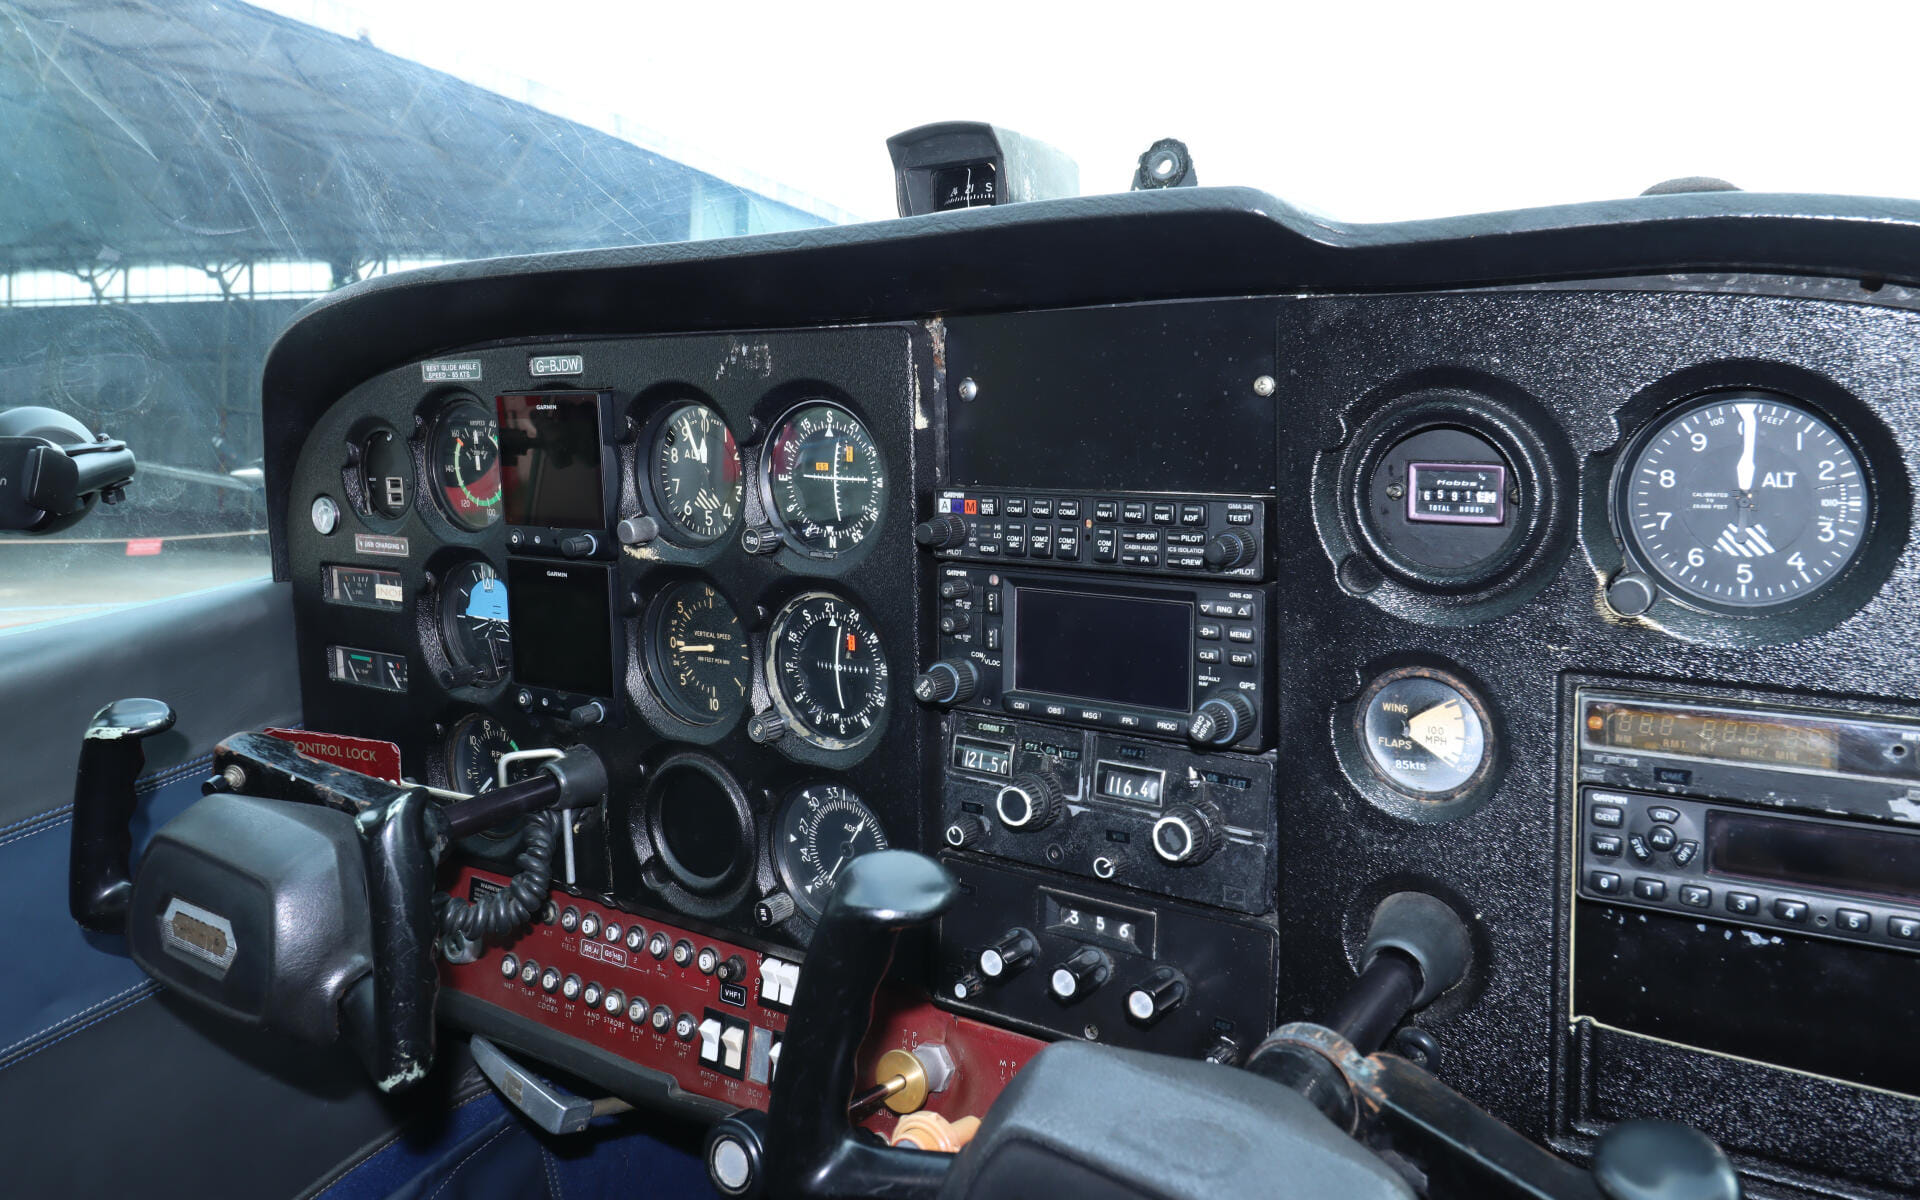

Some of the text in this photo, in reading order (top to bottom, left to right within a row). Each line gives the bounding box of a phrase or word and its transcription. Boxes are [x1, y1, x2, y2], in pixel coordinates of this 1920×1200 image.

[985, 182, 993, 192] S
[536, 358, 579, 373] G-BJDW
[428, 371, 446, 379] SPEED
[826, 410, 833, 423] S
[1709, 417, 1725, 427] 100
[1761, 415, 1786, 427] FEET
[800, 417, 811, 431] 15
[849, 419, 860, 433] 21
[783, 440, 795, 453] 12
[1690, 432, 1708, 452] 9
[1797, 431, 1803, 451] 1
[671, 447, 679, 463] 8
[445, 465, 455, 473] 140
[1817, 460, 1836, 481] 2
[778, 473, 789, 482] E
[1436, 479, 1478, 487] Hobbs
[1659, 468, 1676, 488] 8
[1761, 471, 1797, 488] ALT
[671, 478, 681, 494] 7
[943, 491, 965, 499] GARMIN
[461, 500, 471, 508] 120
[684, 500, 692, 516] 6
[966, 501, 975, 512] M
[1428, 504, 1485, 514] TOTAL HOURS
[486, 508, 496, 517] 100
[722, 503, 733, 519] 4
[1006, 506, 1023, 514] COM1
[1032, 507, 1049, 515] COM2
[1058, 508, 1076, 516] COM3
[1124, 511, 1142, 519] NAV2
[705, 510, 713, 526] 5
[1154, 513, 1170, 521] DME
[1183, 514, 1199, 522] ADF
[1228, 514, 1248, 522] TEST
[1656, 512, 1673, 531] 7
[851, 529, 864, 543] 33
[1817, 521, 1836, 542] 3
[829, 535, 837, 549] N
[1031, 535, 1049, 543] COM2
[1058, 537, 1075, 545] COM3
[1097, 539, 1112, 547] COM
[1180, 534, 1201, 542] PILOT
[375, 542, 400, 550] CHARGING
[1167, 545, 1177, 553] ICS
[1180, 558, 1202, 566] CREW
[1688, 547, 1705, 567] 6
[1786, 551, 1806, 571] 4
[546, 570, 568, 578] GARMIN
[946, 569, 967, 577] GARMIN
[1736, 563, 1753, 584] 5
[1229, 591, 1242, 599] GNS
[677, 601, 684, 614] 5
[824, 602, 834, 613] 21
[1216, 605, 1233, 614] RNG
[802, 608, 811, 621] S
[849, 608, 860, 621] 24
[694, 630, 732, 641] VERTICAL SPEED
[787, 631, 798, 643] 15
[1229, 630, 1251, 639] MENU
[670, 636, 677, 649] 0
[1199, 651, 1214, 660] CLR
[1232, 654, 1247, 663] ENT
[785, 661, 794, 673] 12
[680, 673, 687, 686] 5
[1198, 675, 1221, 683] DEFAULT
[1239, 681, 1257, 690] GPS
[794, 692, 804, 703] E
[709, 698, 720, 711] 10
[1013, 701, 1025, 709] CDI
[1382, 702, 1409, 714] WING
[1047, 706, 1061, 715] OBS
[1082, 711, 1098, 720] MSG
[483, 719, 491, 730] 15
[860, 715, 871, 729] N
[1121, 716, 1134, 725] FPL
[1156, 721, 1177, 731] PROC
[839, 724, 846, 734] 3
[978, 722, 999, 732] COMM
[1197, 719, 1212, 739] PUSH
[469, 735, 477, 745] 10
[1378, 736, 1413, 750] FLAPS
[1425, 735, 1448, 746] MPH
[290, 740, 377, 762] ONTROL LOCK
[1062, 750, 1079, 759] TEST
[964, 749, 1008, 775] 121.50
[1395, 759, 1428, 771] 85kts
[826, 786, 839, 800] 33
[808, 796, 820, 812] 30
[1592, 793, 1629, 805] GARMIN
[1595, 811, 1621, 822] IDENT
[1655, 811, 1670, 820] ON
[799, 817, 809, 835] 27
[1652, 835, 1671, 844] ALT
[1596, 841, 1615, 850] VFR
[799, 847, 812, 863] 24
[1678, 846, 1692, 861] OFF
[1600, 877, 1609, 888] 0
[1645, 885, 1652, 896] 1
[1690, 892, 1700, 903] 2
[1736, 899, 1747, 910] 3
[1784, 907, 1797, 919] 4
[1848, 917, 1860, 928] 5
[1901, 925, 1912, 937] 6
[541, 994, 557, 1004] TURN
[724, 989, 741, 1000] VHF1
[537, 1001, 559, 1013] COORD
[583, 1010, 601, 1020] LAND
[603, 1016, 625, 1030] STROBE
[674, 1040, 692, 1052] PITOT
[700, 1070, 718, 1083] PITOT
